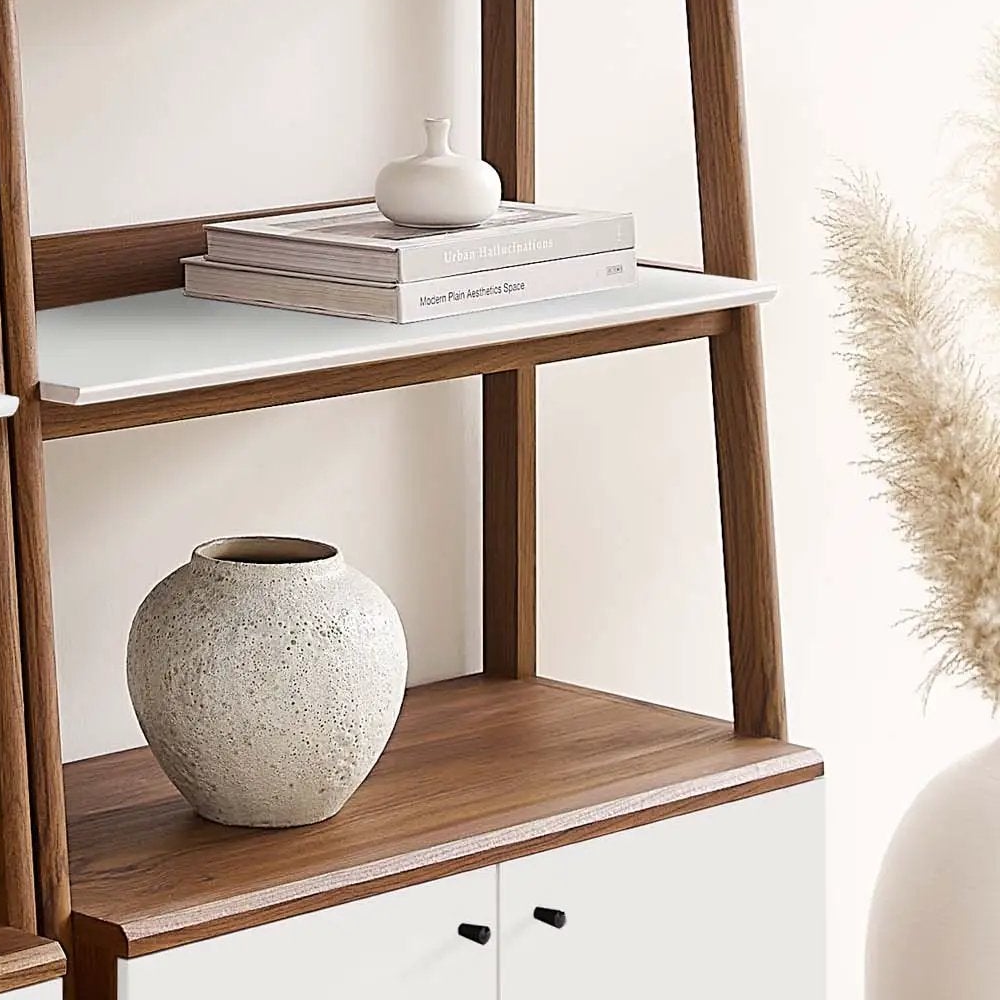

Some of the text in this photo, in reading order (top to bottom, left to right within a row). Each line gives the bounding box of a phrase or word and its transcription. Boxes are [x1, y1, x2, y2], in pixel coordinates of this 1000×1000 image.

[443, 249, 475, 263] Urban
[420, 281, 526, 306] Modern Plain Aesthetics Space
